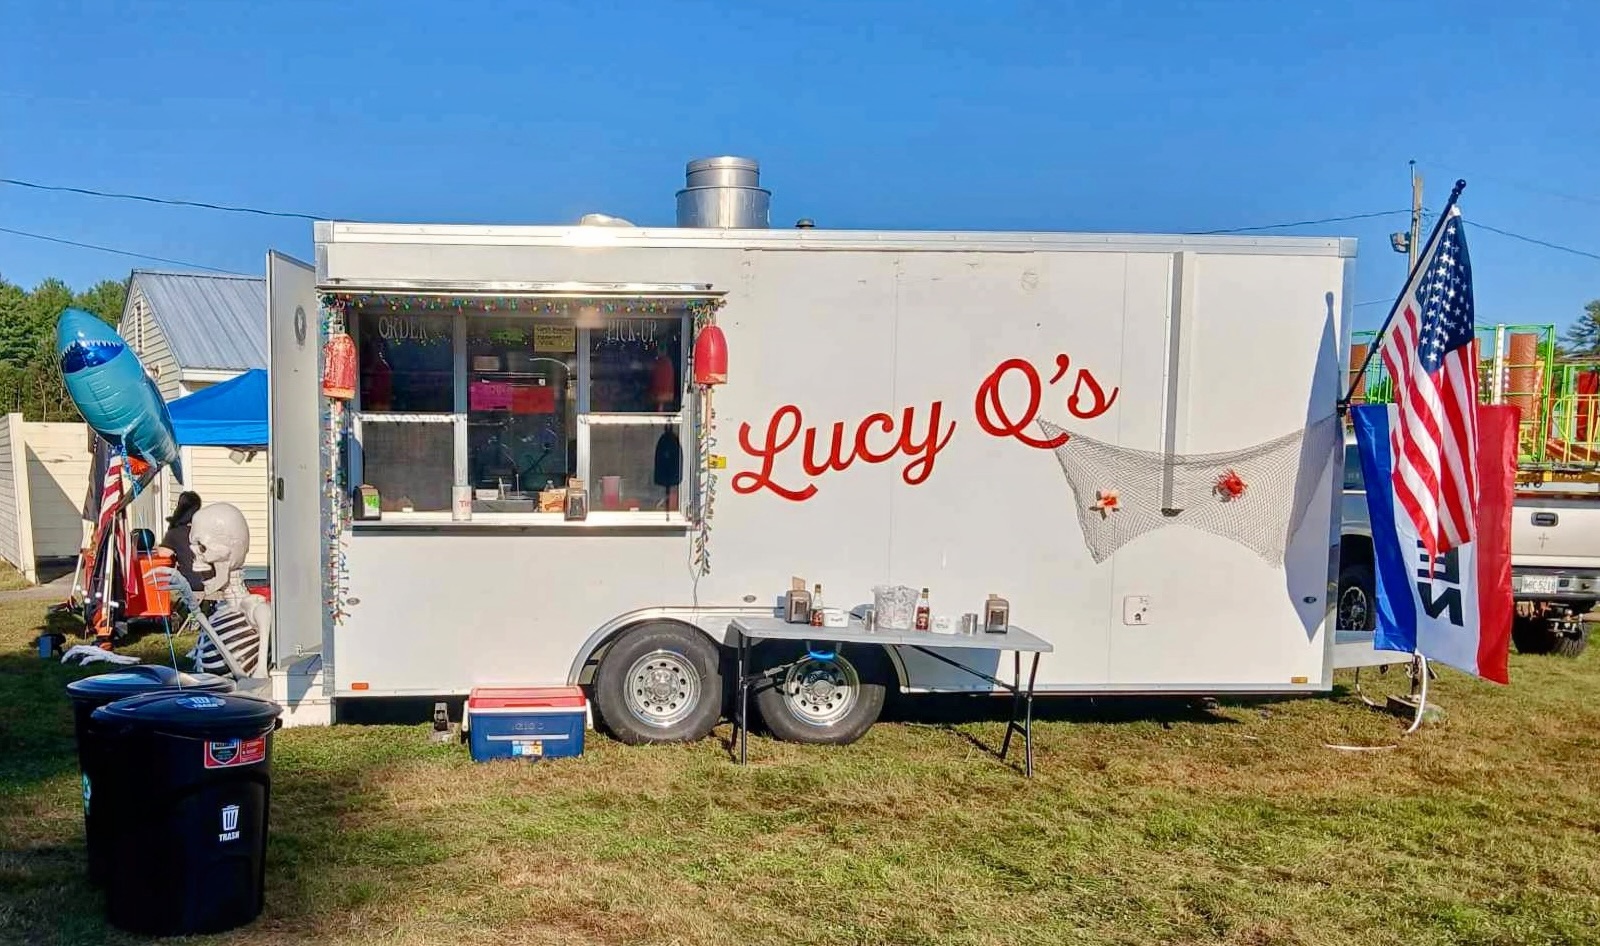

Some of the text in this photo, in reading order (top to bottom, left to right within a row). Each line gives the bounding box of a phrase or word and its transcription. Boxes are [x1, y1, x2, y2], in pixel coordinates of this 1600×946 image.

[378, 315, 428, 339] ORDER
[731, 353, 1120, 502] Lucy Q's
[218, 830, 240, 842] TRASH
